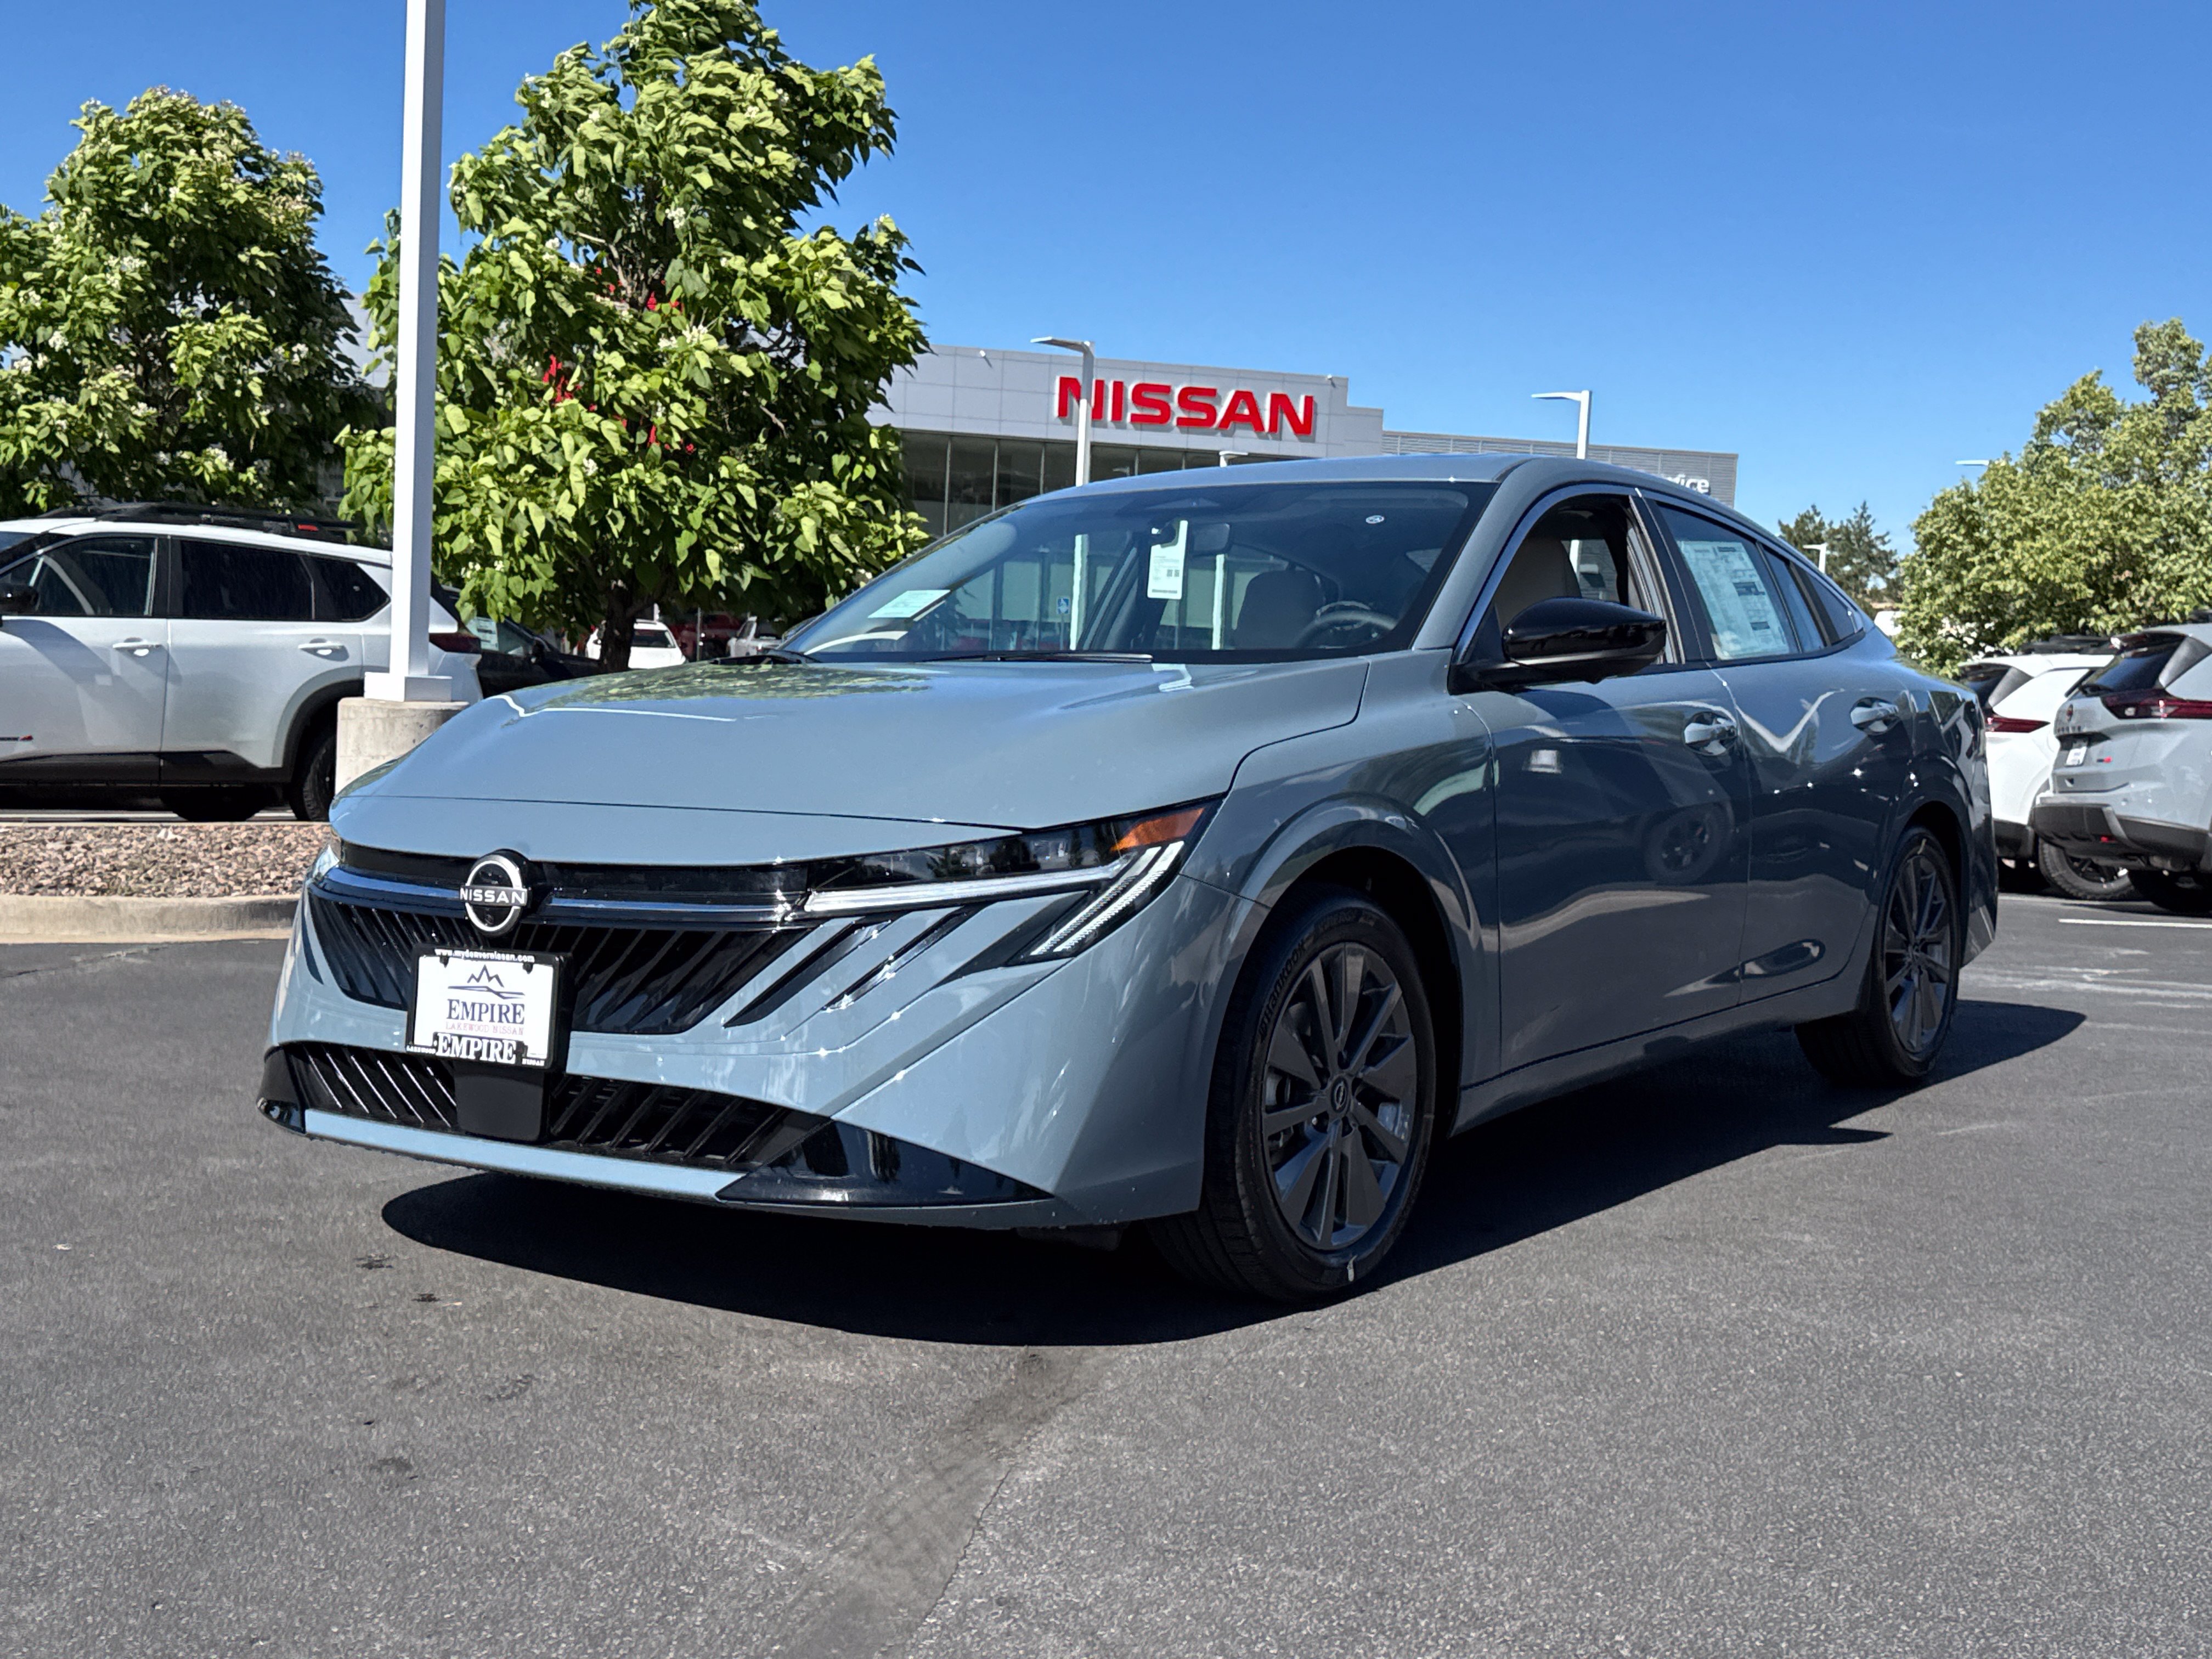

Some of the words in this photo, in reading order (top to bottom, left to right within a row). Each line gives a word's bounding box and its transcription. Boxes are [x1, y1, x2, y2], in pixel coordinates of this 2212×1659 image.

[1057, 376, 1314, 436] NISSAN
[460, 888, 524, 904] NISSAN
[447, 999, 525, 1025] EMPIRE
[445, 1022, 489, 1032] LAKEWOOD
[493, 1025, 524, 1035] NISSAN
[436, 1032, 516, 1064] EMPIRE
